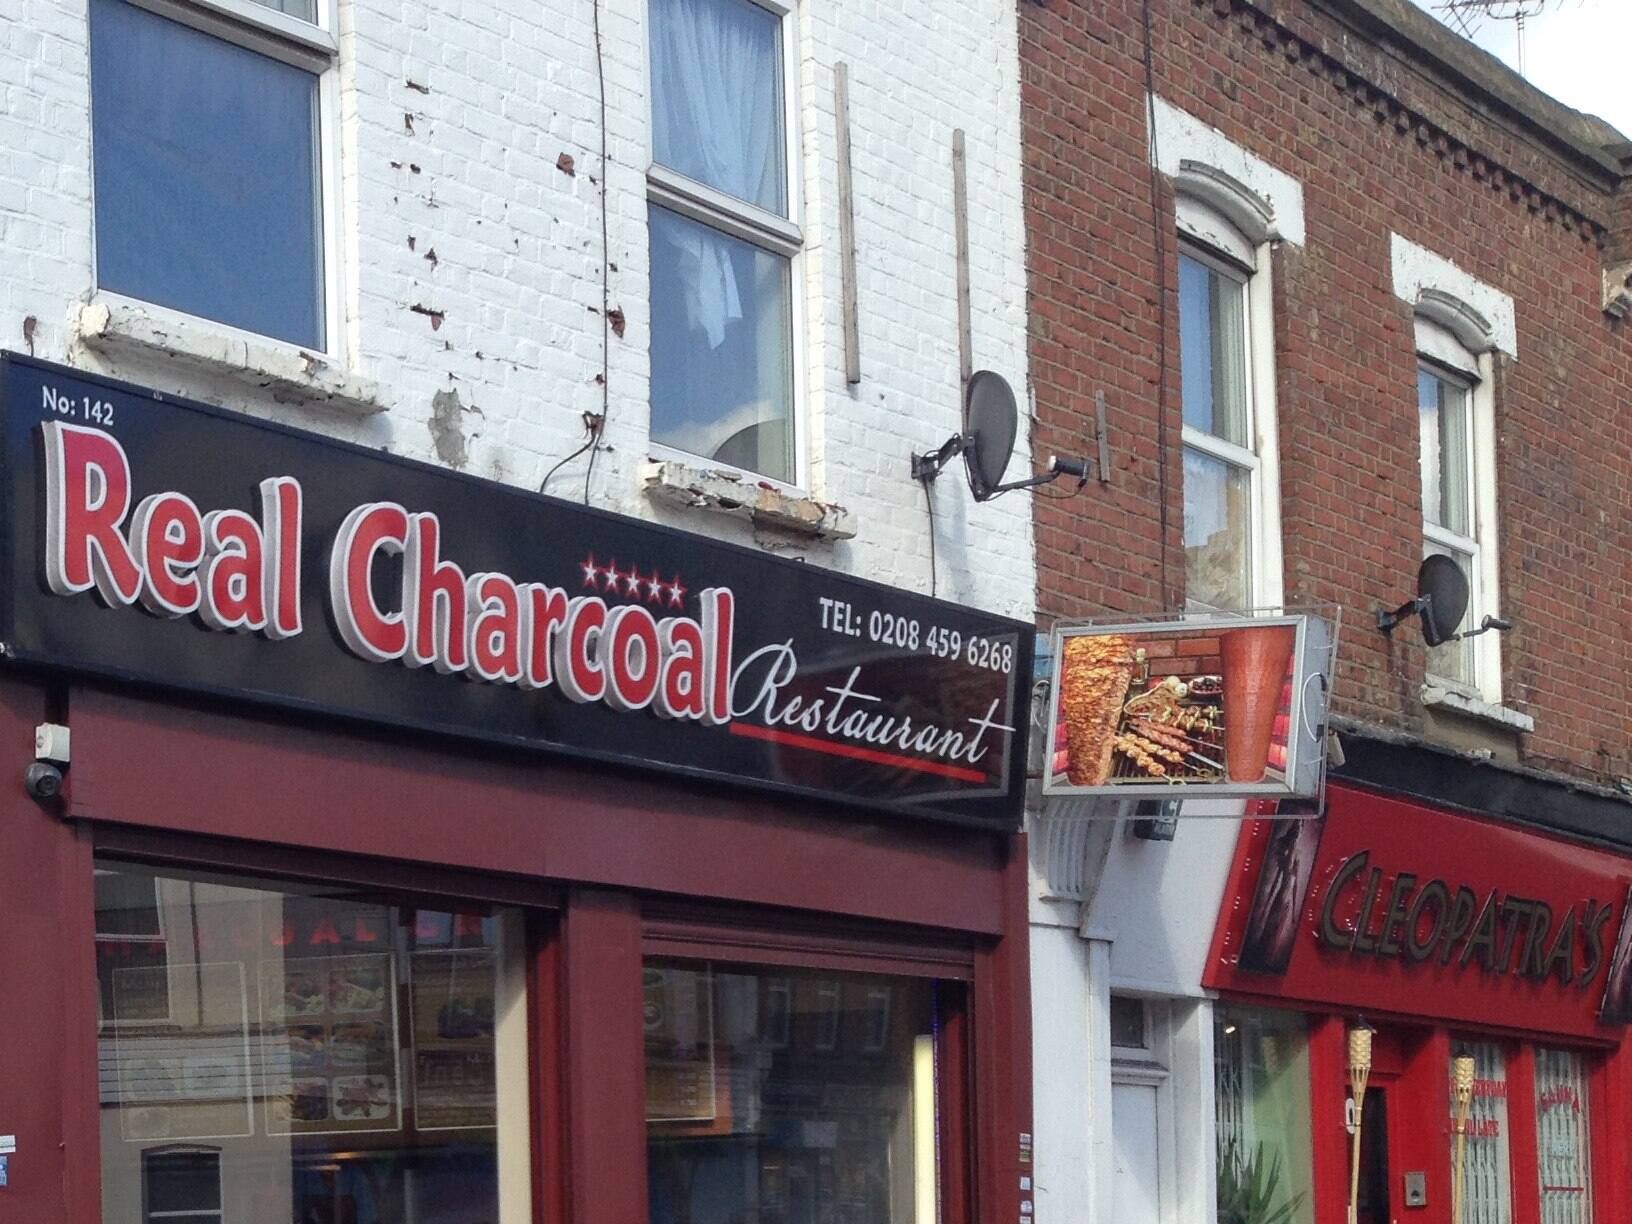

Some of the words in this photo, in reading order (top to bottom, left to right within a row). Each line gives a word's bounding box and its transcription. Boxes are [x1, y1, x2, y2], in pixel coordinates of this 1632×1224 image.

[42, 385, 75, 416] No:
[83, 396, 114, 426] 142
[41, 419, 304, 641] Real
[330, 500, 735, 726] Charcoal
[819, 597, 862, 638] TEL:
[869, 610, 920, 651] 0208
[926, 625, 961, 661] 459
[968, 636, 1012, 674] 6268
[730, 638, 1017, 763] Restaurant
[1321, 850, 1613, 988] CLEOPATRA'S
